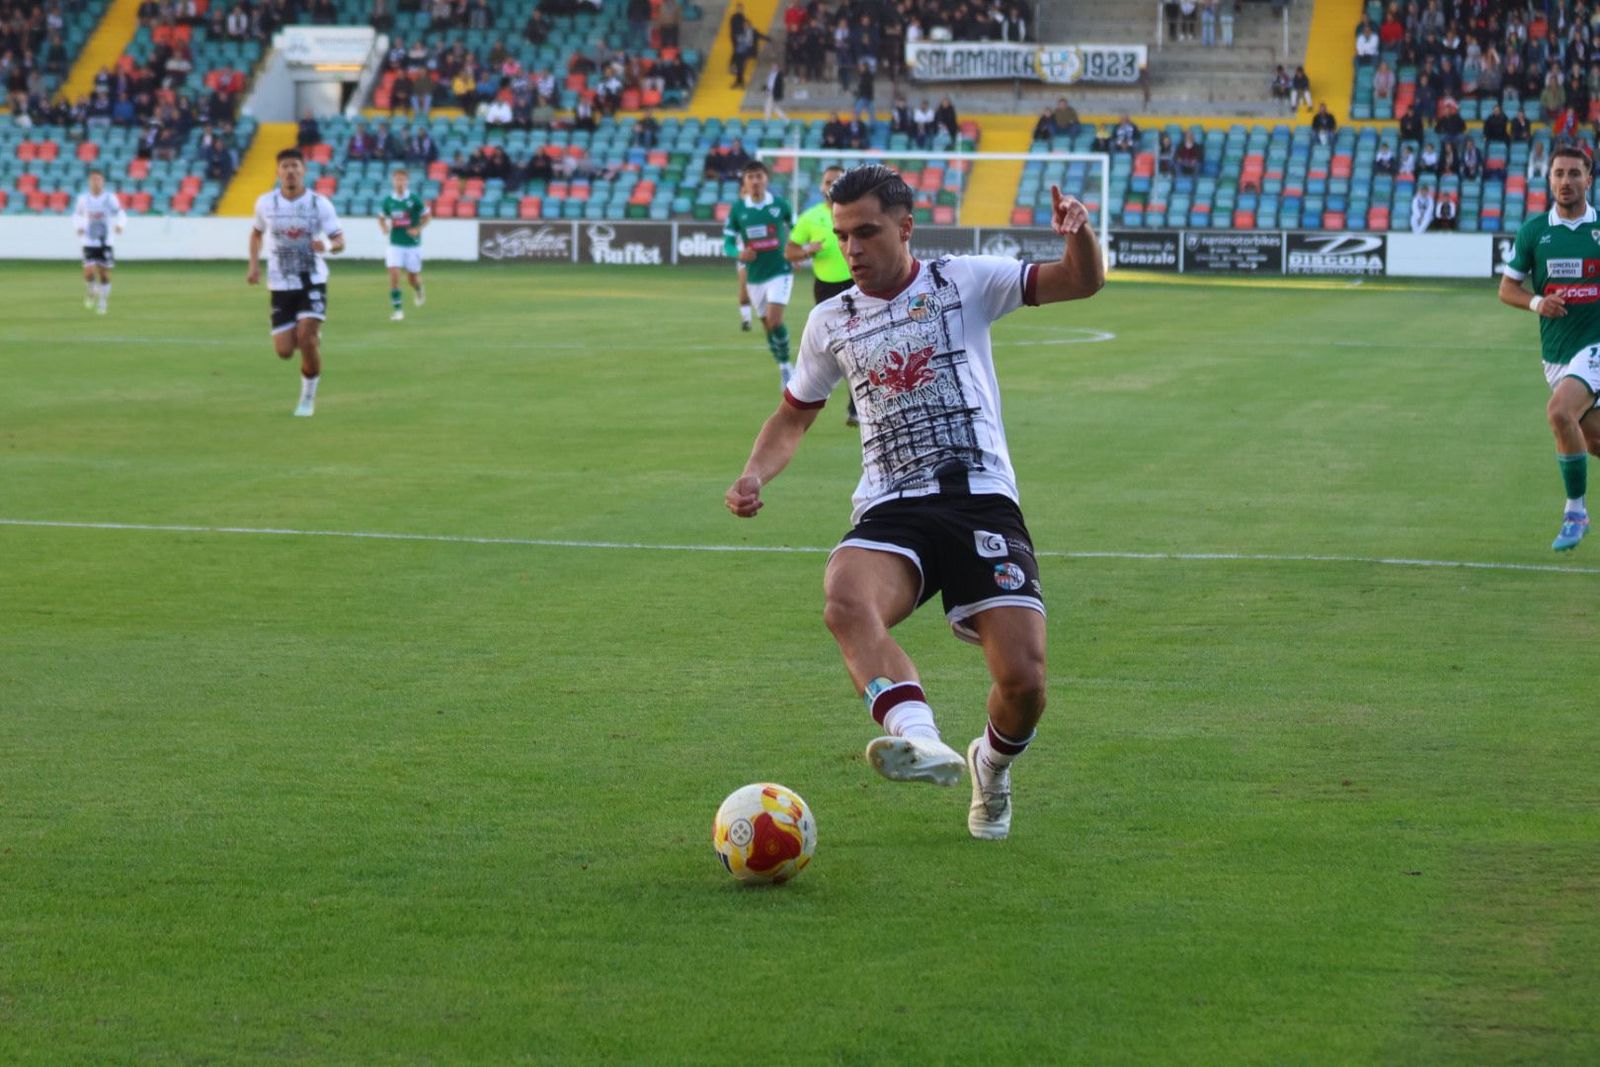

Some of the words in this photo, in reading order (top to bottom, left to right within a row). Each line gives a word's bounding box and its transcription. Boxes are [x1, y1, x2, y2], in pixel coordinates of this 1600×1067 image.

[915, 48, 1035, 75] SALAMANCA
[1083, 51, 1138, 78] 1923
[679, 232, 727, 257] elim
[1118, 252, 1176, 265] Gonzalo
[869, 382, 961, 417] SALAMANCA
